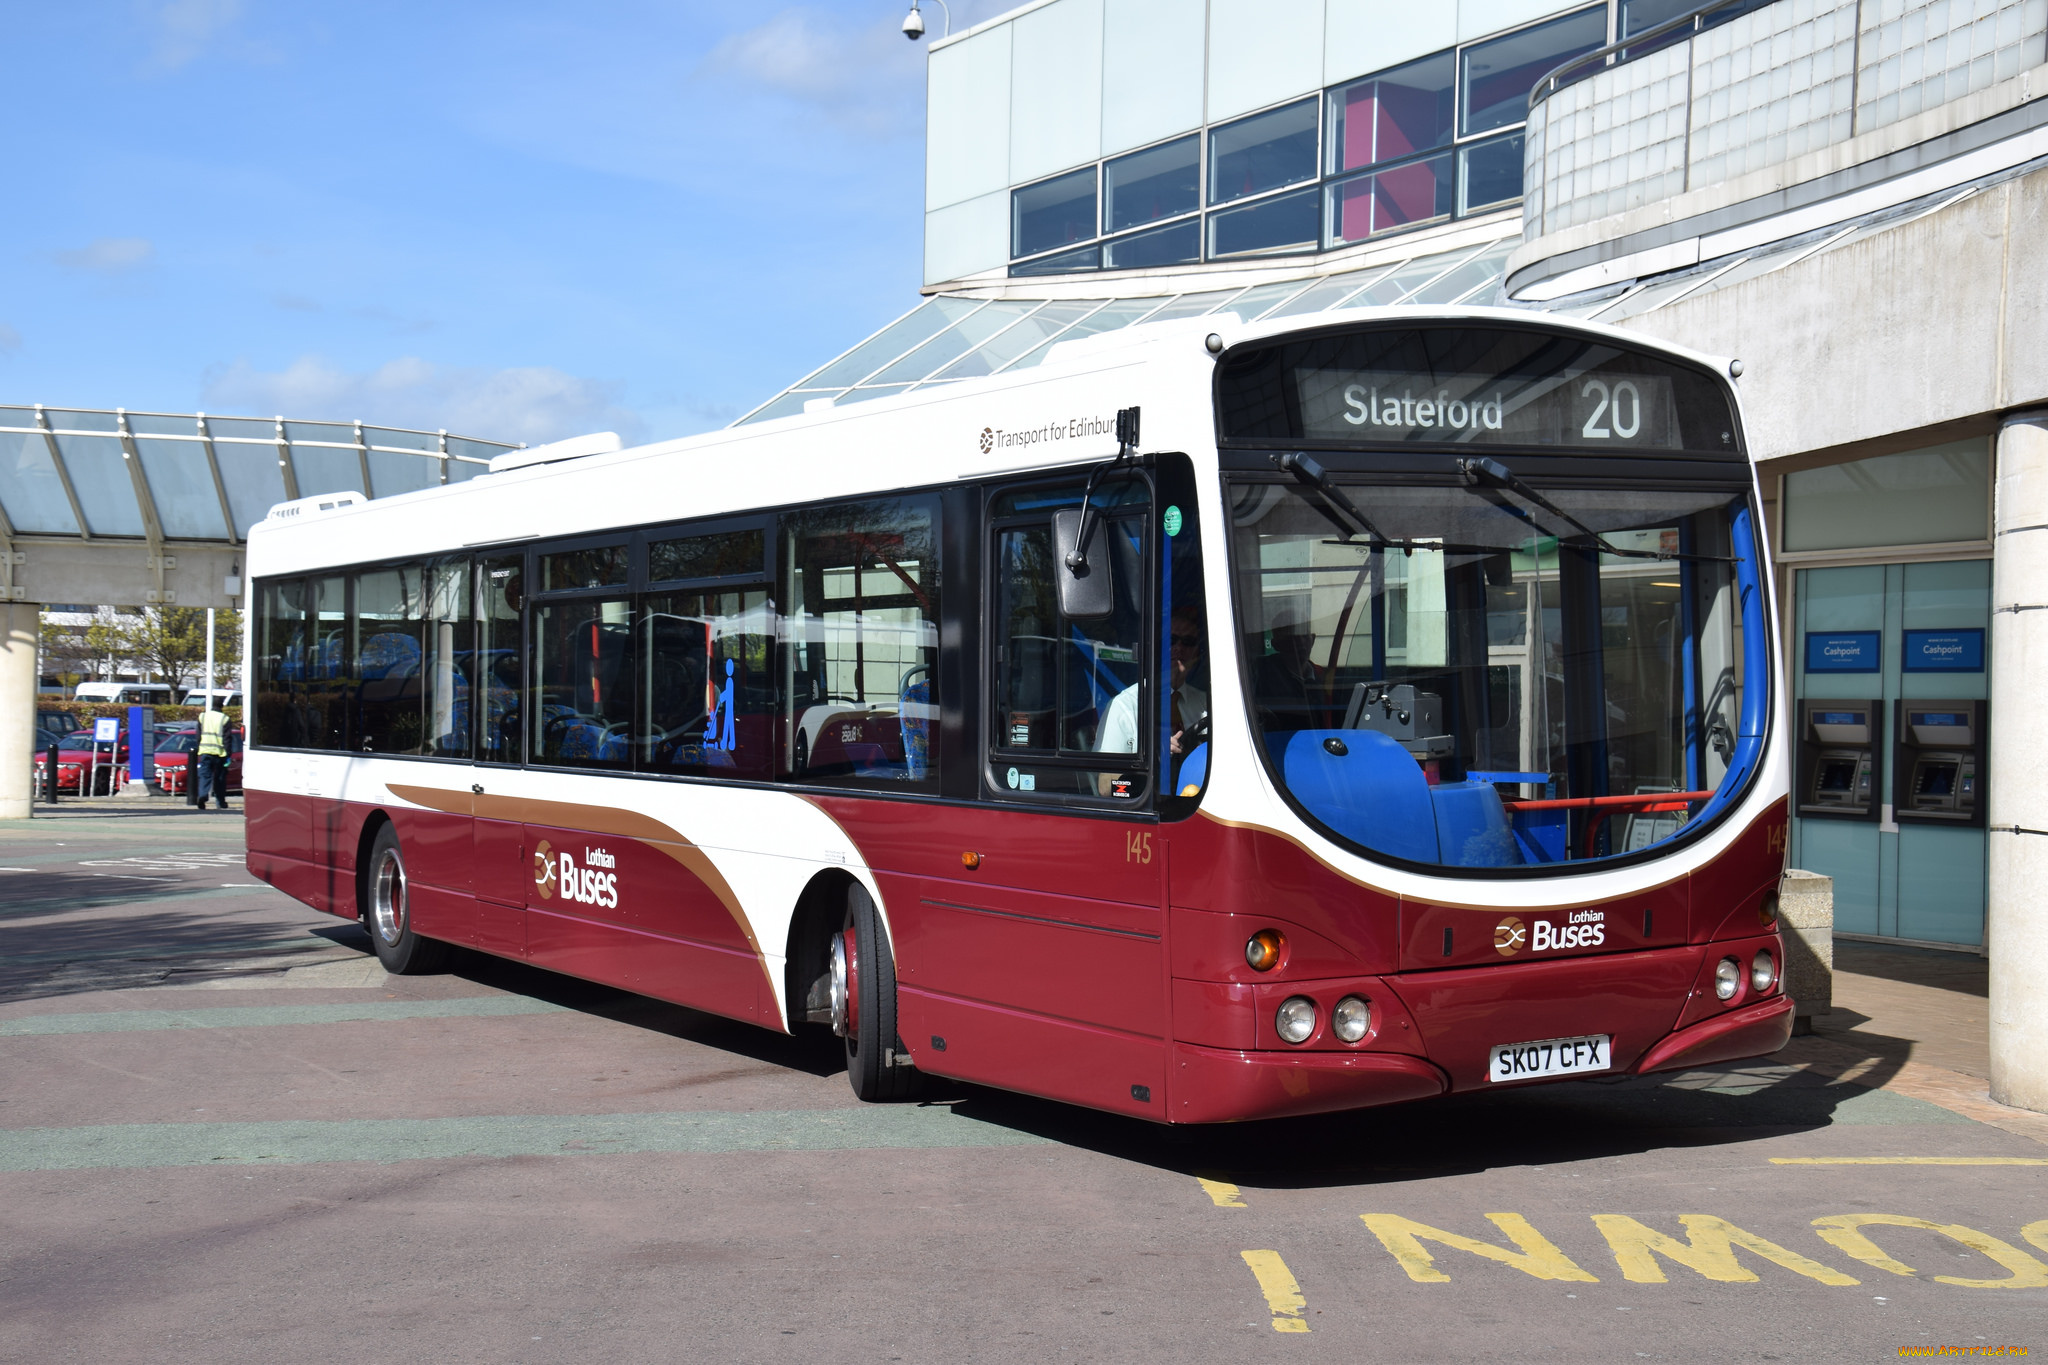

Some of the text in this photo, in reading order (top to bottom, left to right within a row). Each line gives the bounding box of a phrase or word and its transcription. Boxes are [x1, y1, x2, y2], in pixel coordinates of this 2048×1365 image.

[1343, 383, 1503, 430] Slateford
[1581, 379, 1641, 439] 20
[996, 415, 1117, 449] Transport for Edinbur
[1824, 646, 1861, 658] Cashpoint
[1922, 644, 1963, 657] Cashpoint
[585, 846, 616, 869] Lothian
[1126, 830, 1152, 865] 145
[559, 852, 618, 909] Buses
[1569, 909, 1605, 924] Lothian
[1532, 920, 1605, 951] Buses
[1499, 1039, 1601, 1075] SK07 CFX
[1359, 1211, 2048, 1288] OWN
